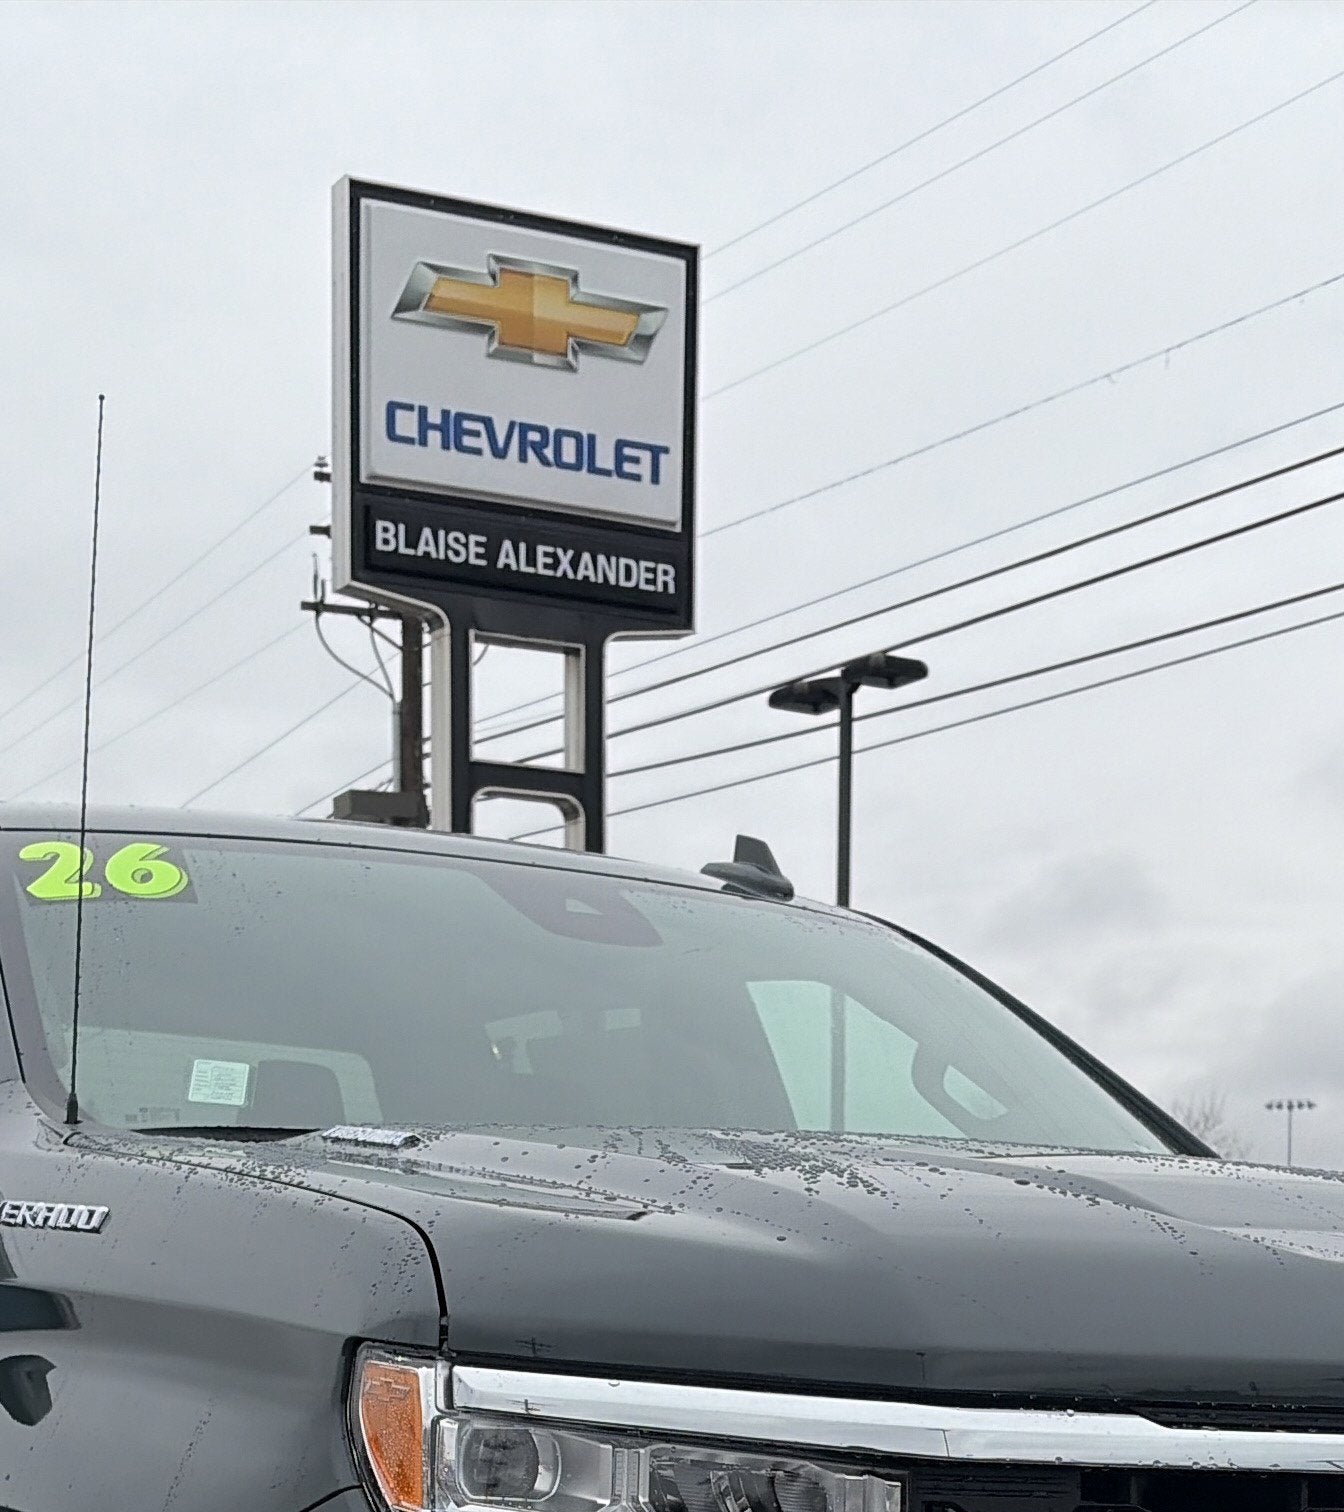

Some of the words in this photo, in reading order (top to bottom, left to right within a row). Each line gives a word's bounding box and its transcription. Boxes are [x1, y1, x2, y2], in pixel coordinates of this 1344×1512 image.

[386, 400, 670, 485] CHEVROLET
[375, 520, 488, 567] BLAISE
[496, 539, 676, 594] ALEXANDER
[19, 841, 189, 900] 26
